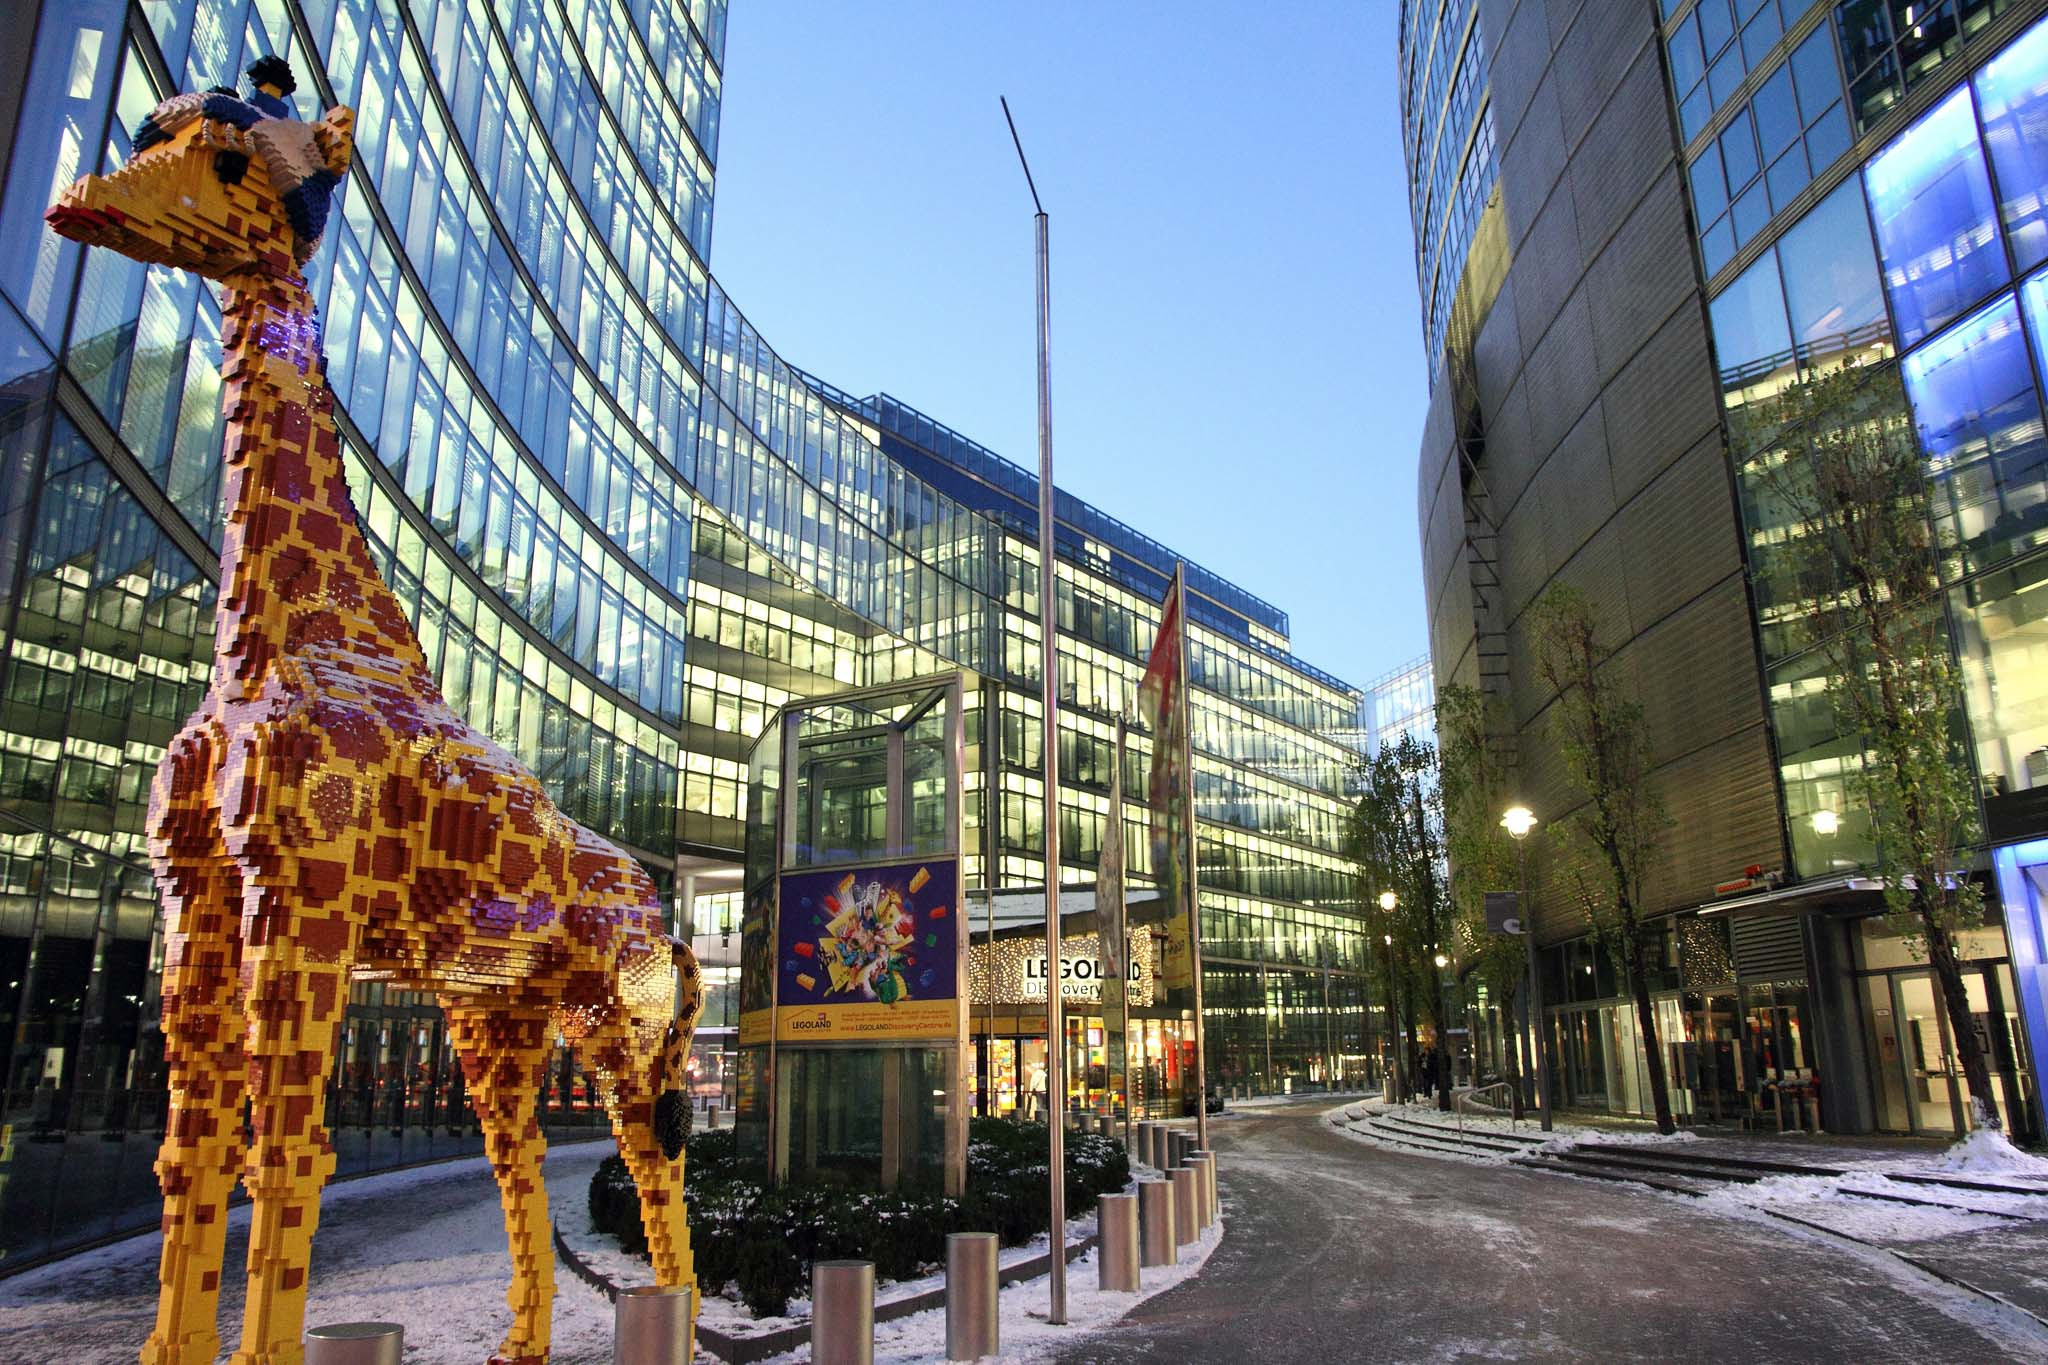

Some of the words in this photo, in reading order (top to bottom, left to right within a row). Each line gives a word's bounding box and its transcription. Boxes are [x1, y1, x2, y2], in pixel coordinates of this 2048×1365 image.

[1027, 957, 1141, 981] LEGOLD
[1027, 981, 1103, 999] Disovery
[792, 1019, 832, 1029] LEGOLAND
